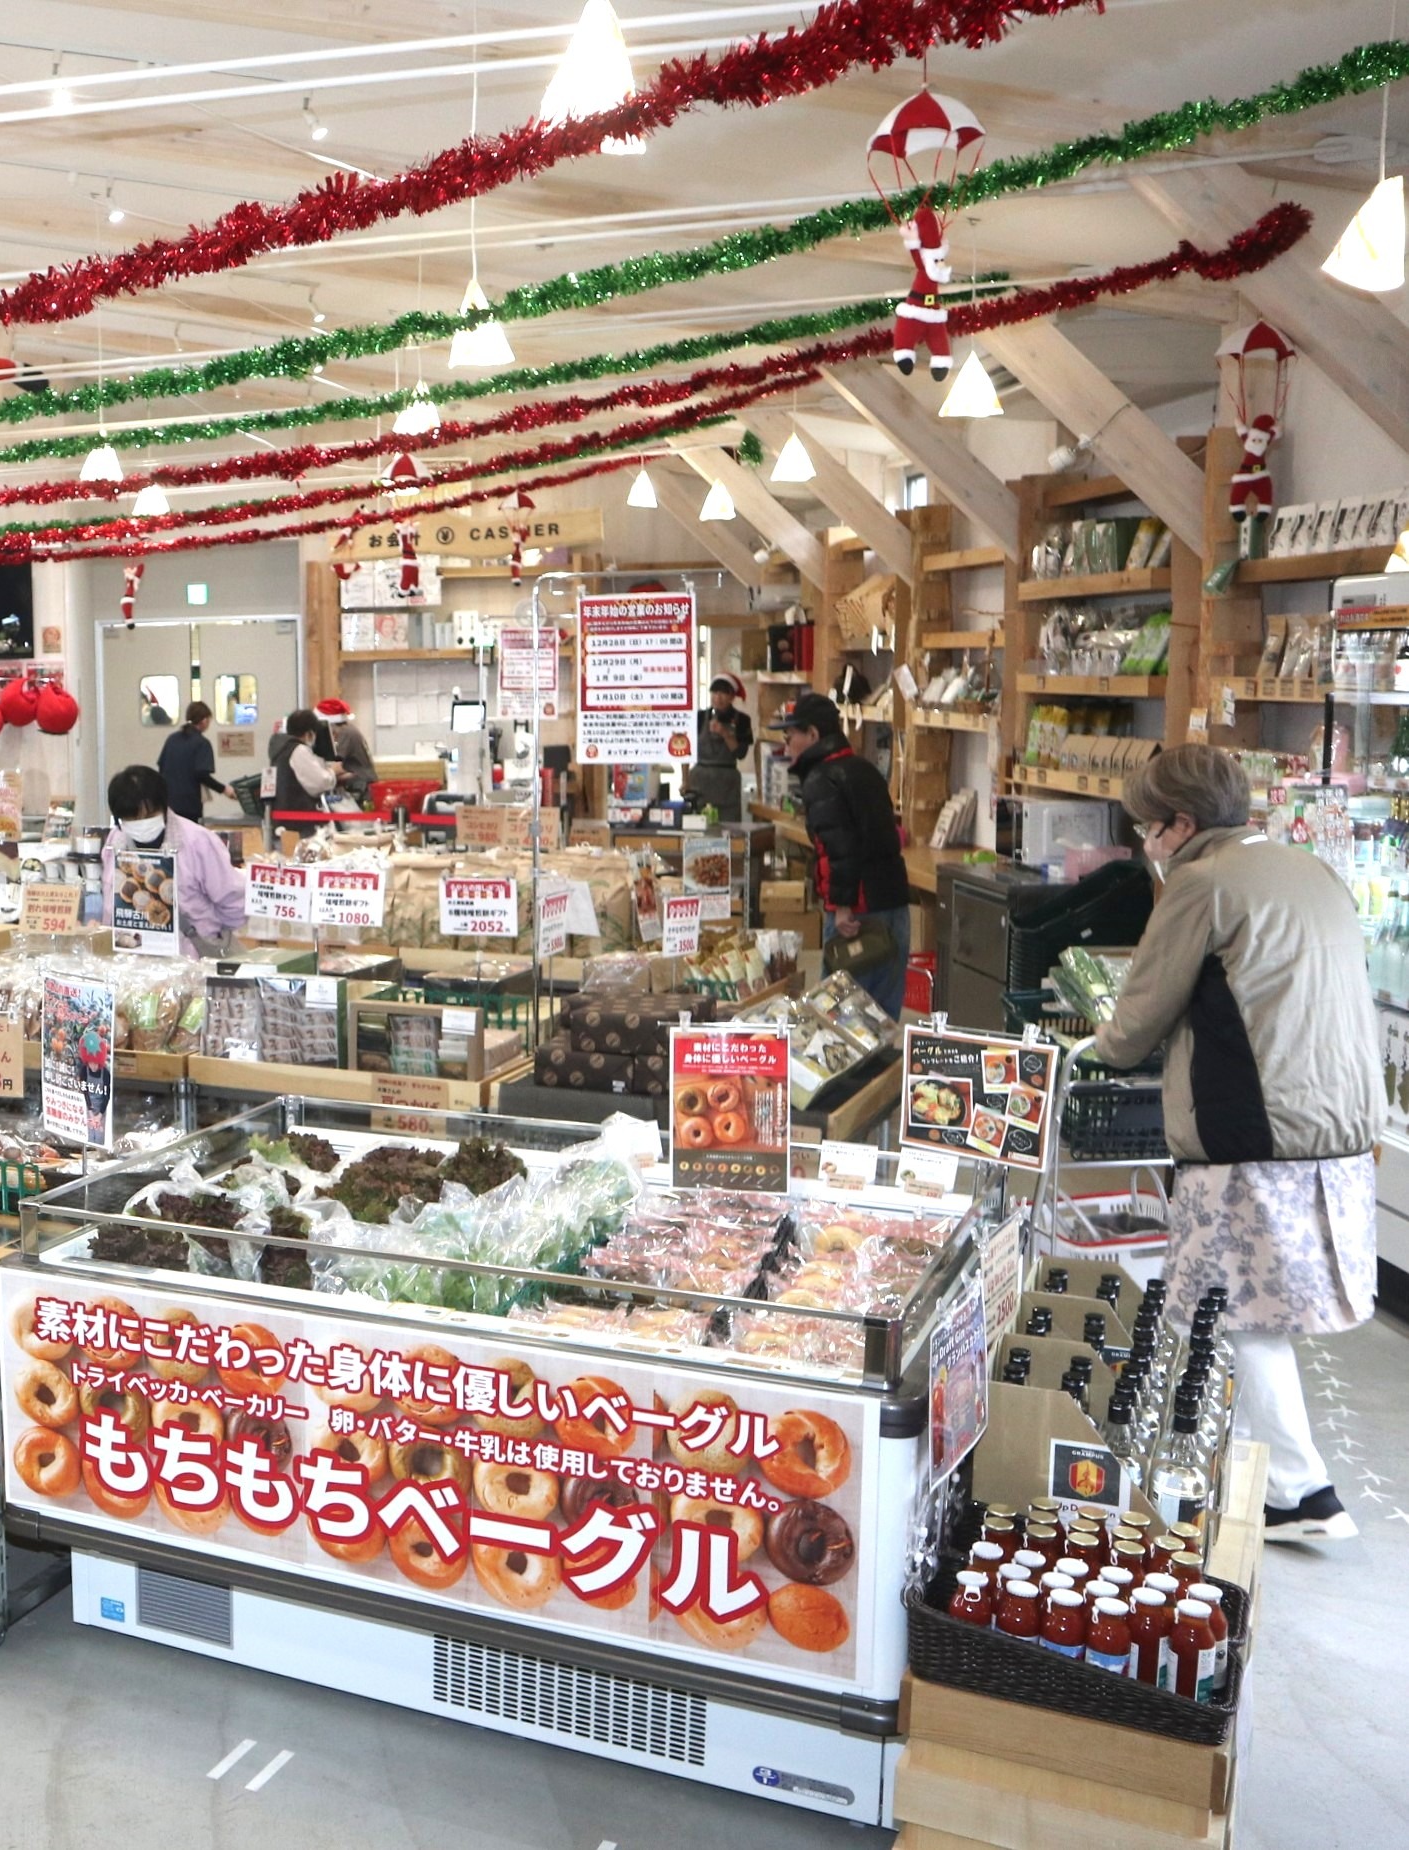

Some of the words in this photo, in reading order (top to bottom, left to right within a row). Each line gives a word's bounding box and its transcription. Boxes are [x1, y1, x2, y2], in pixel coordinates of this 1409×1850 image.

[583, 603, 689, 617] 年末年始の営業のお知らせ
[683, 1053, 777, 1065] 身体に優しいベーグル
[693, 1043, 767, 1054] 素材にこだわった
[36, 1295, 781, 1462] 素材にこだわった身体に優しいベーグル
[70, 1363, 307, 1423] トライベッカ・ベーカリー
[330, 1406, 784, 1515] 卵・バター・牛乳は使用しておりません。
[82, 1416, 768, 1624] もちもちベーグル
